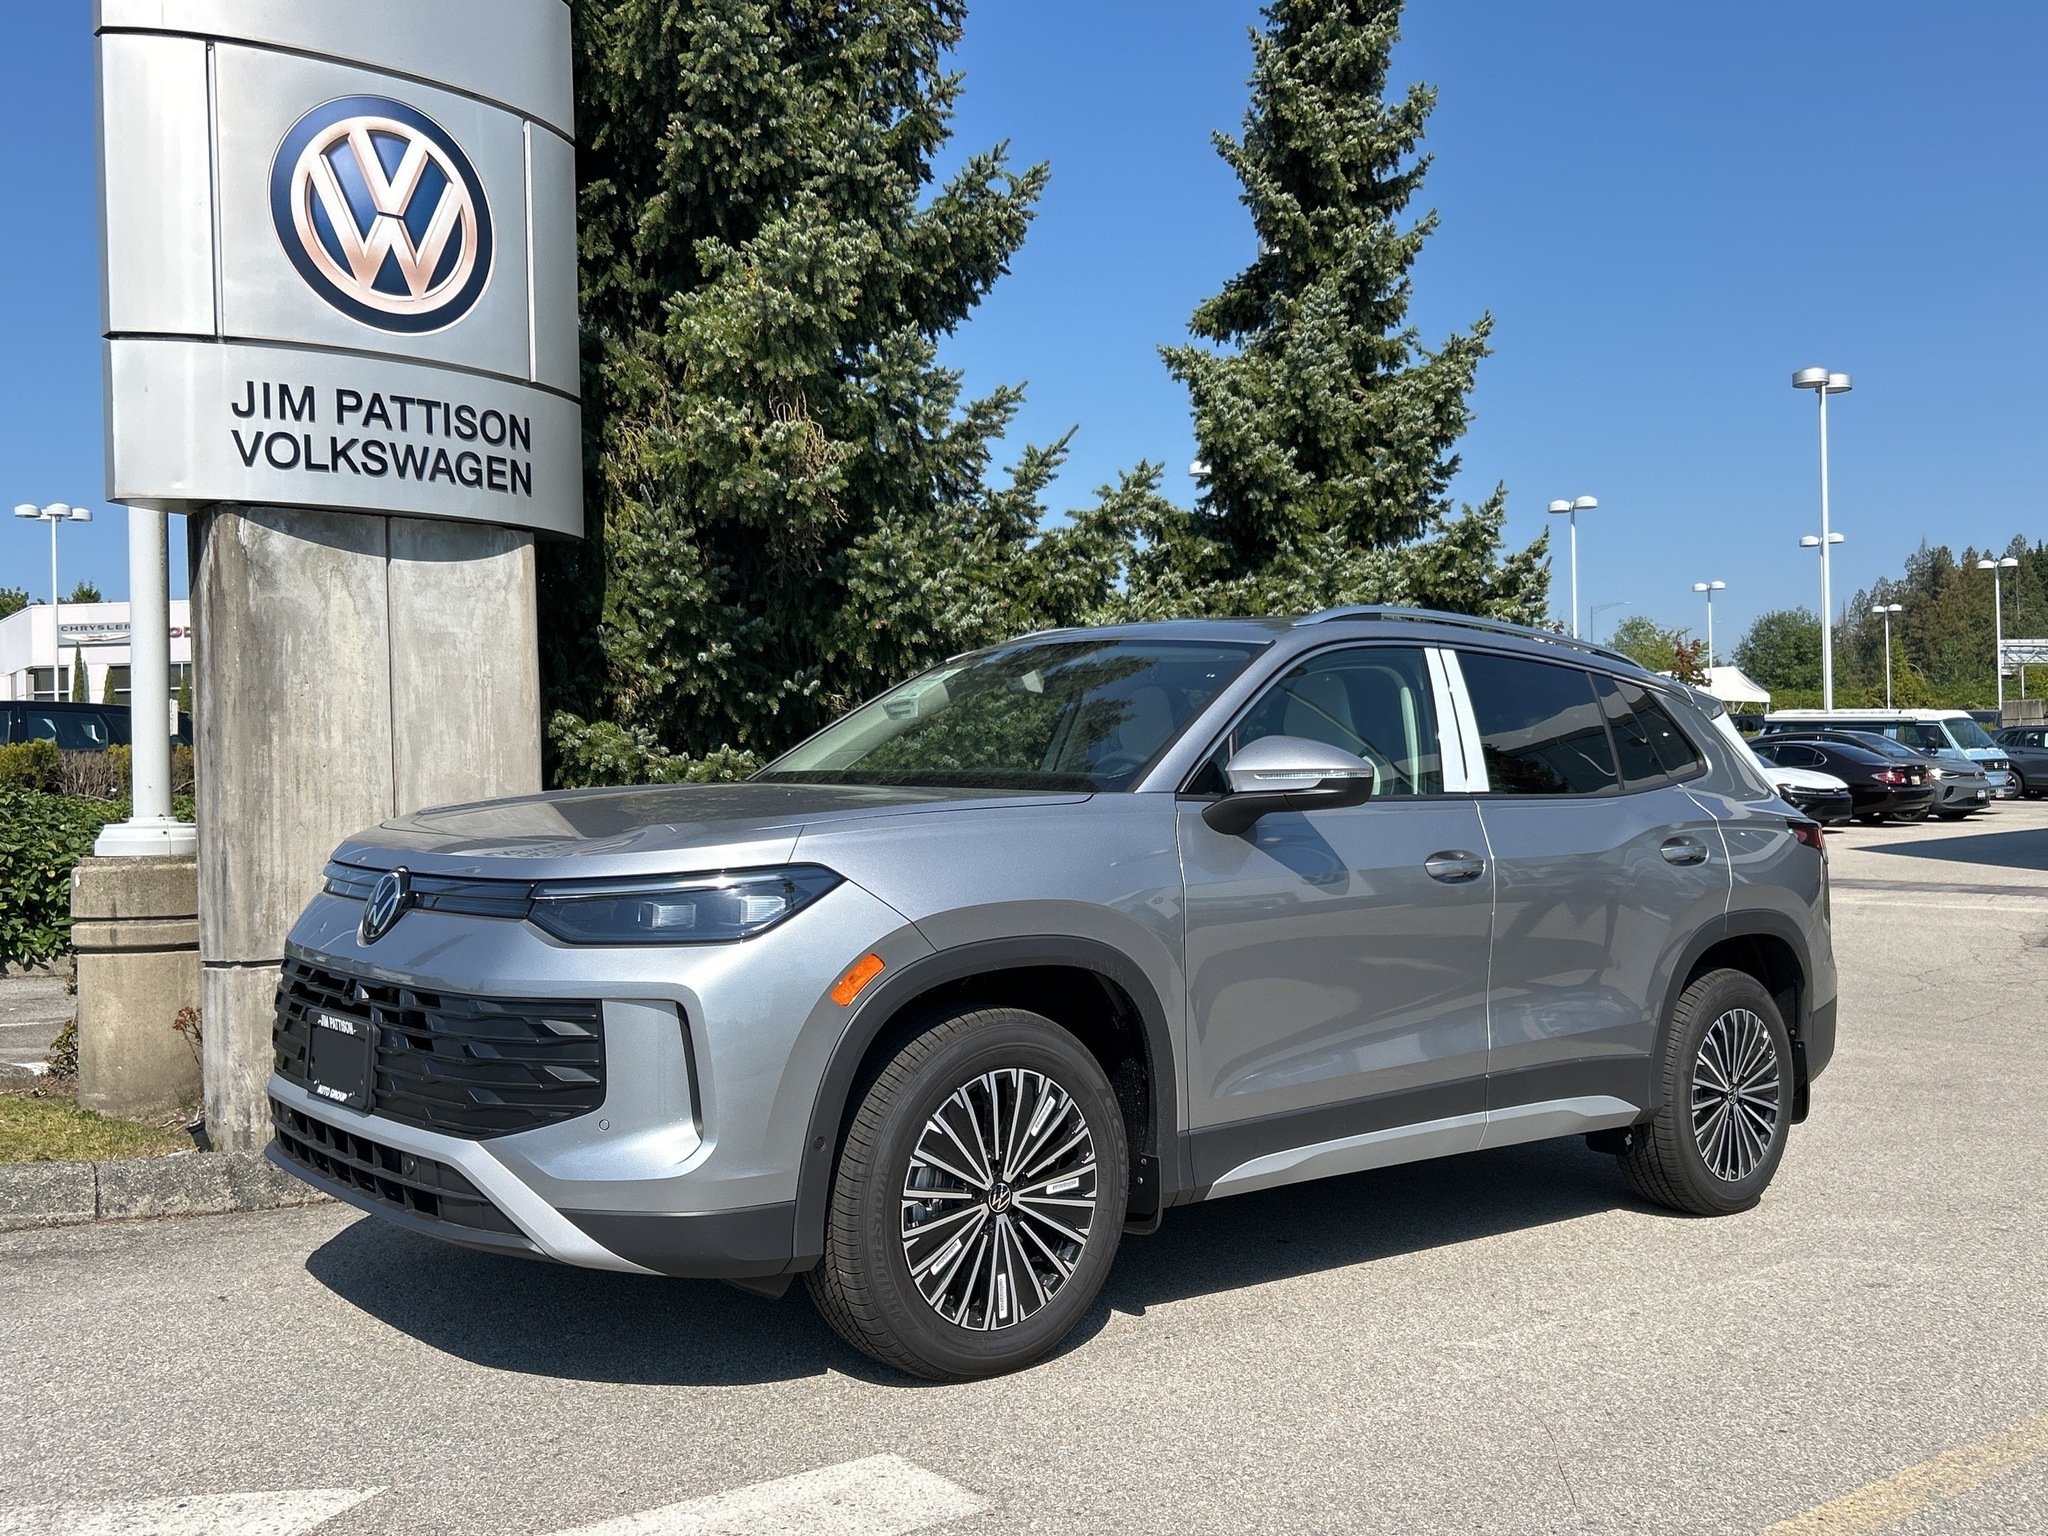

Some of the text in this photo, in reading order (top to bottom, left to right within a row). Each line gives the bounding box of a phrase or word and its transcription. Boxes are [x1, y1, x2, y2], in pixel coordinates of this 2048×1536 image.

[231, 380, 532, 453] JIM PATTISON
[231, 429, 533, 497] VOLKSWAGEN
[60, 623, 131, 632] CHRYSLER
[329, 1016, 355, 1035] PATTISON
[317, 1084, 348, 1102] AUTO GROUP
